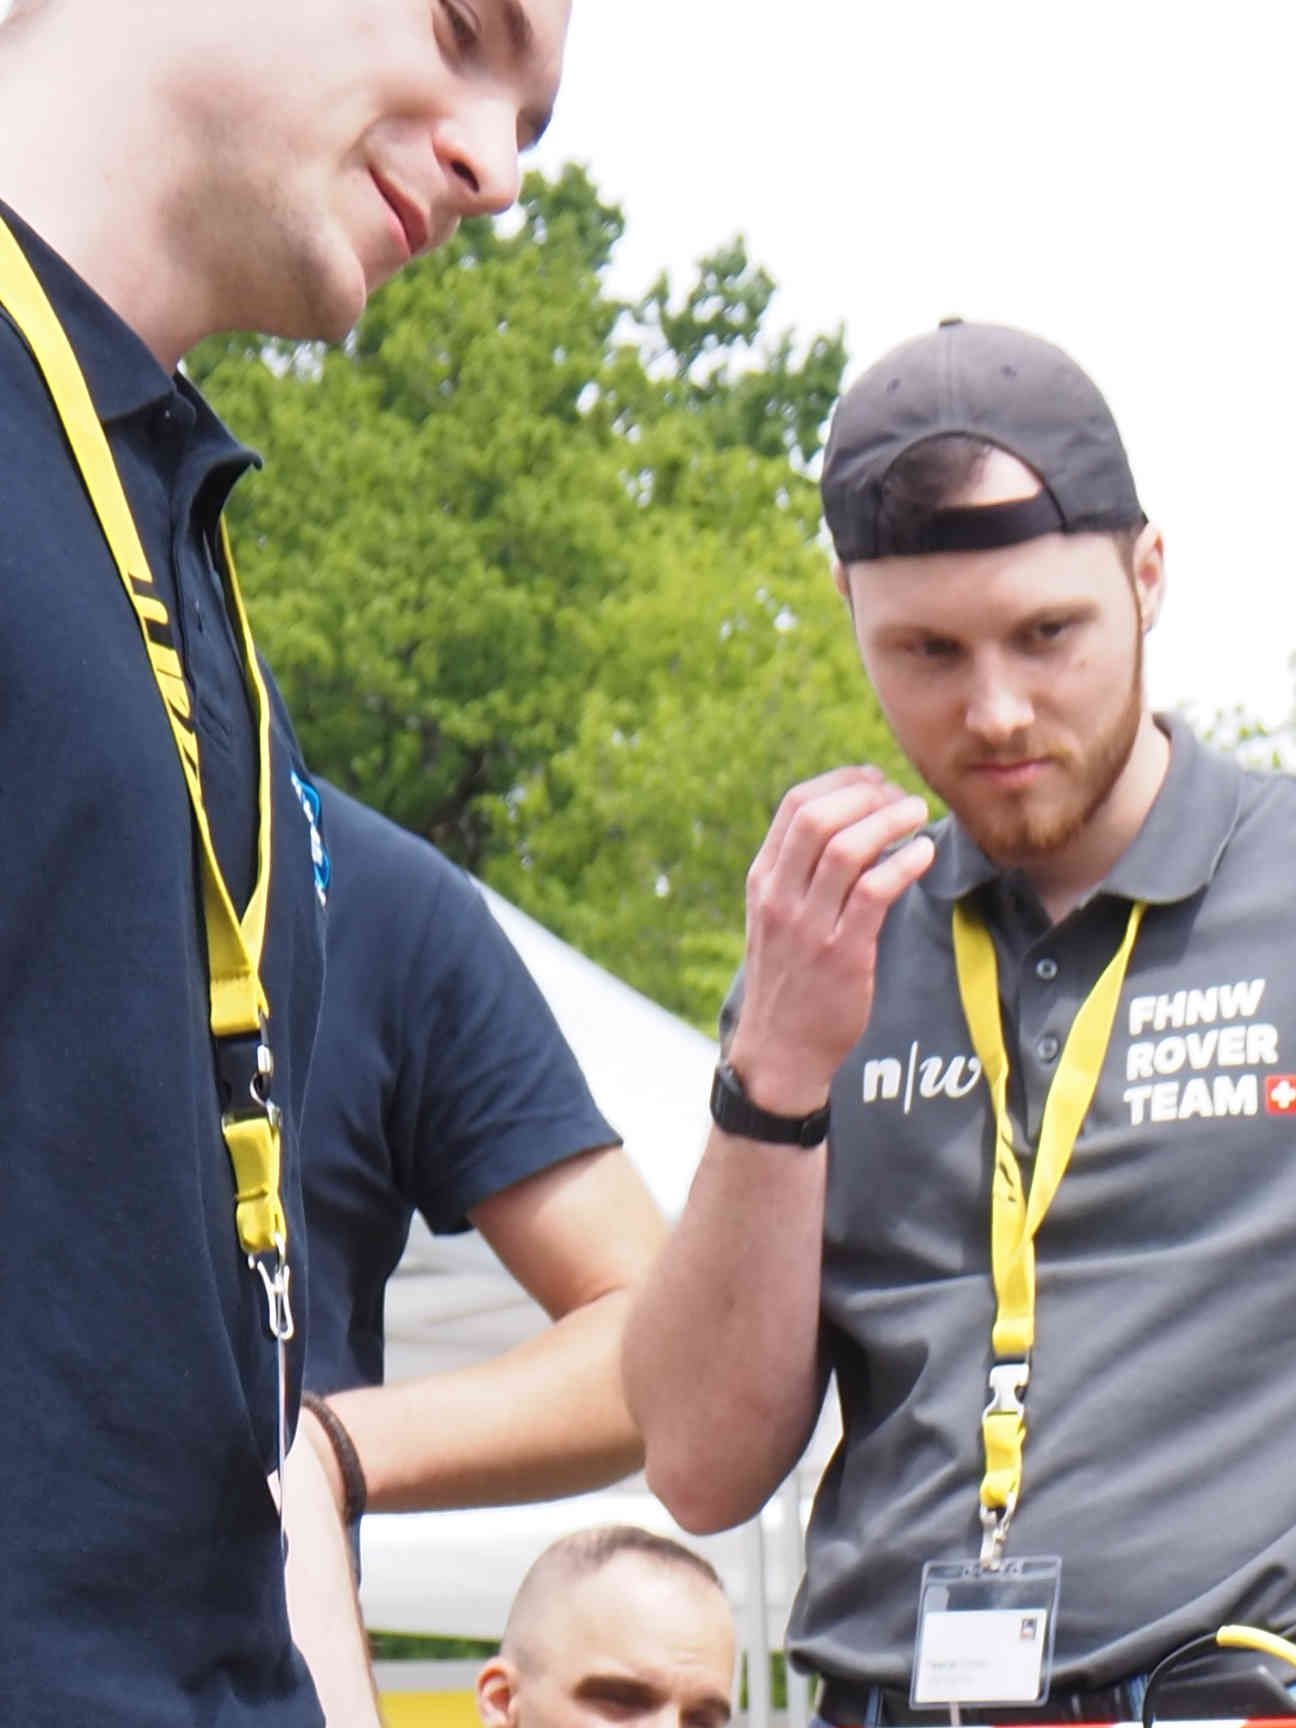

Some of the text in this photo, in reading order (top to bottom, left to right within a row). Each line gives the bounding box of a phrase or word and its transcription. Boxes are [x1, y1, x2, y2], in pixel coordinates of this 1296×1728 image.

[1129, 979, 1265, 1035] FHNW
[1127, 1023, 1278, 1080] ROVER
[1123, 1074, 1257, 1126] TEAM
